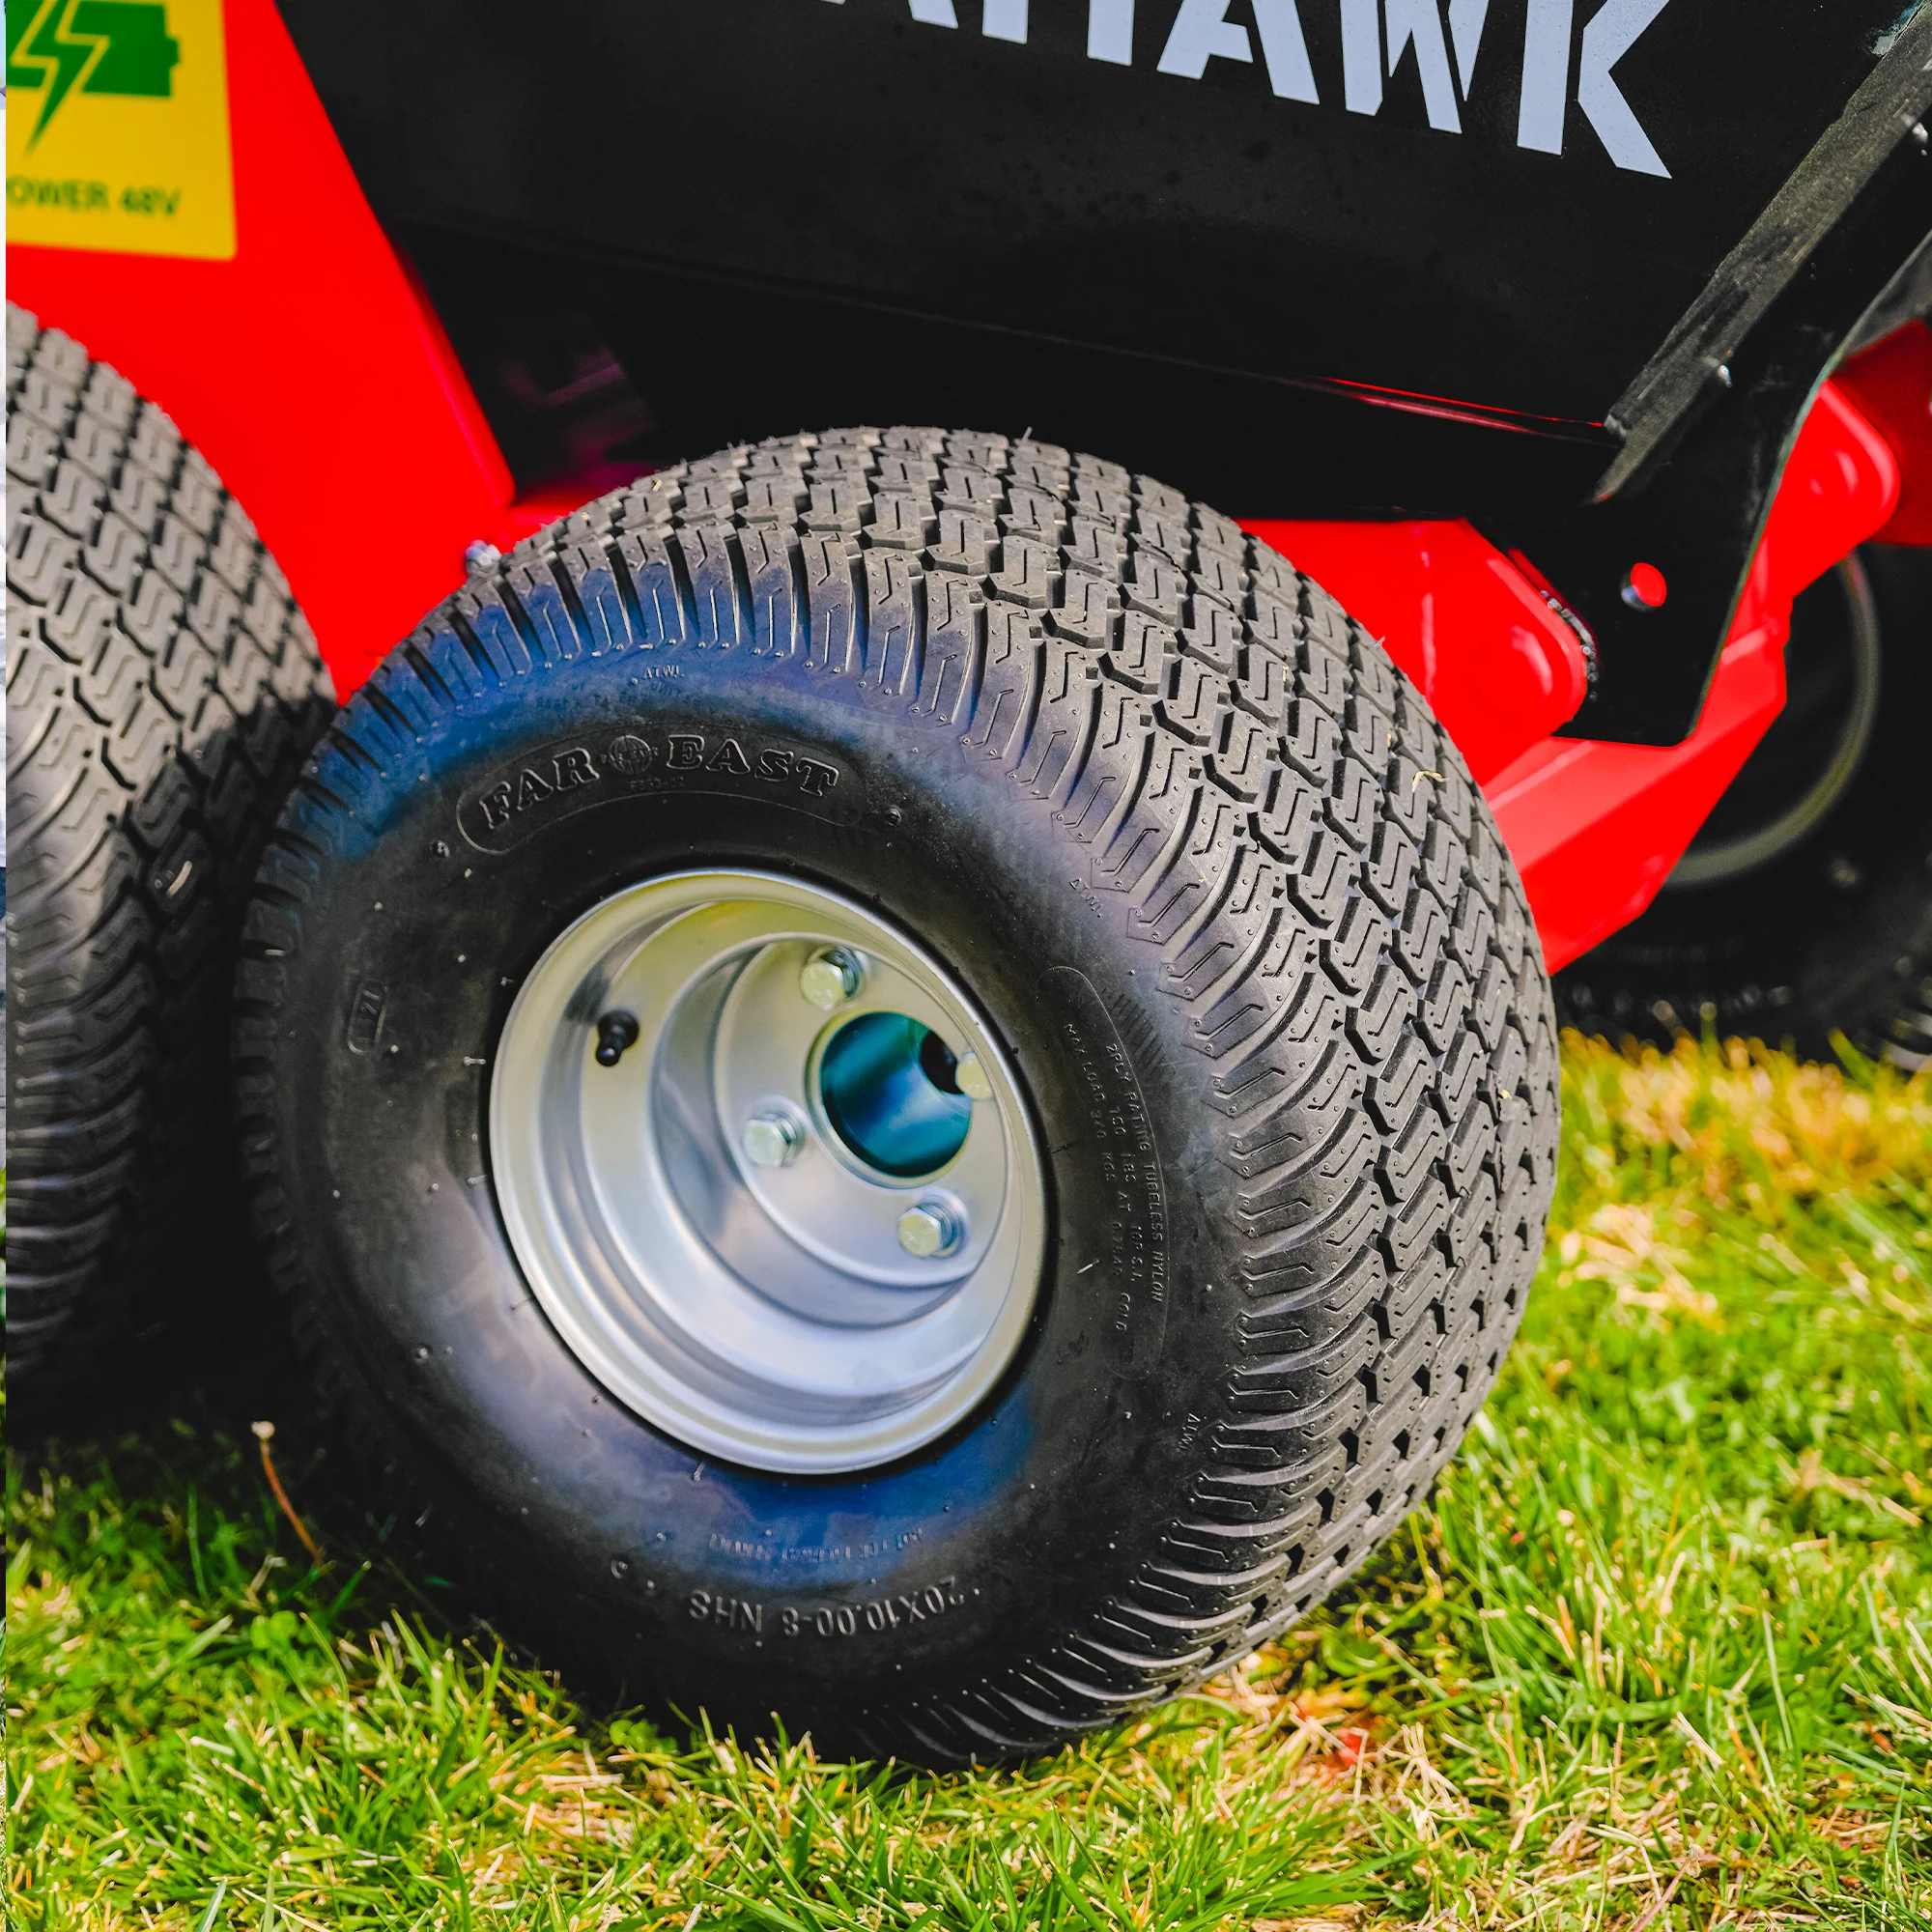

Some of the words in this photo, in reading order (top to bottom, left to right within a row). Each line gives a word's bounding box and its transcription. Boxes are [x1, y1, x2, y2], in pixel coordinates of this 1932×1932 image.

[819, 0, 1672, 179] AWK
[479, 747, 601, 830] FAR
[666, 734, 840, 798] EAST
[1063, 1023, 1085, 1060] MAX
[1082, 1061, 1106, 1102] LOAD
[1122, 1091, 1152, 1152] RATING
[1116, 1190, 1131, 1212] AT
[1142, 1161, 1164, 1243] TUBELESS
[1151, 1250, 1165, 1303] NYLON
[1115, 1293, 1132, 1331] COLD
[689, 1588, 762, 1634] NHS
